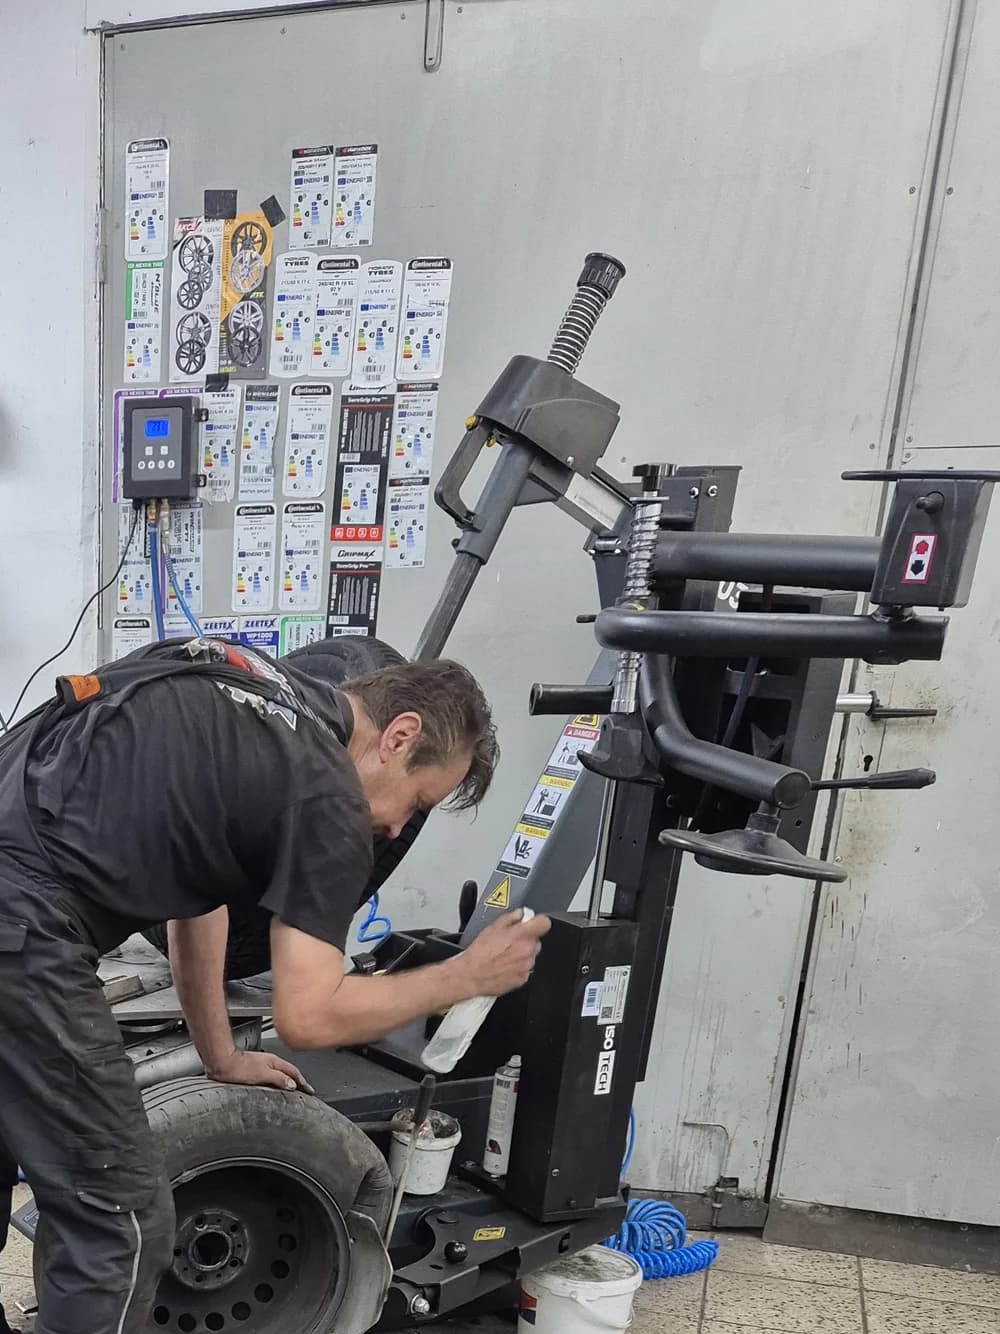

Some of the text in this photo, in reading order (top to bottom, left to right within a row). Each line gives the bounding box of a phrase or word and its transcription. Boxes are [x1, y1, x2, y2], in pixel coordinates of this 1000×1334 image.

[203, 619, 235, 631] ZEETEX
[245, 617, 277, 629] ZEETEX
[572, 729, 597, 738] DANGER
